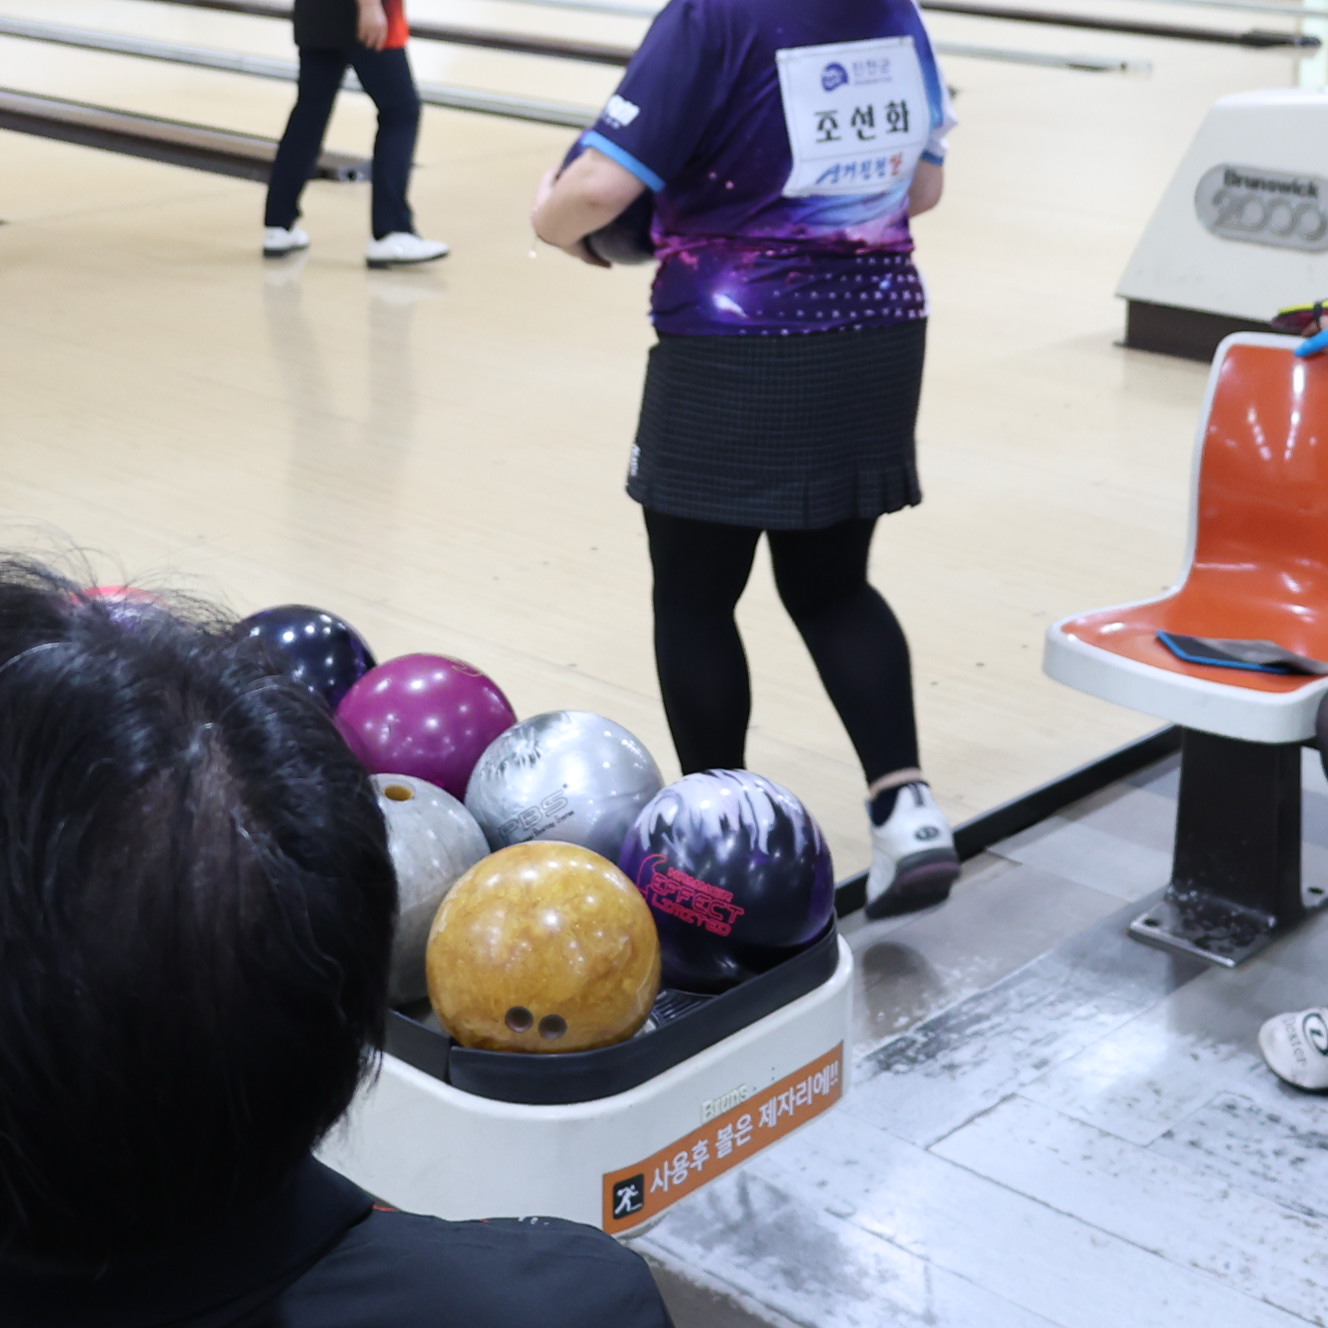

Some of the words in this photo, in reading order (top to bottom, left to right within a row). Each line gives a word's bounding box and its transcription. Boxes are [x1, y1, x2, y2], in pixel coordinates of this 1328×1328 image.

[814, 99, 910, 144] 조선화
[1223, 169, 1320, 199] Brunswick
[496, 788, 569, 844] PBS
[650, 872, 745, 925] EFFECT
[649, 1138, 710, 1194] 사용후
[714, 1112, 754, 1160] 볼은
